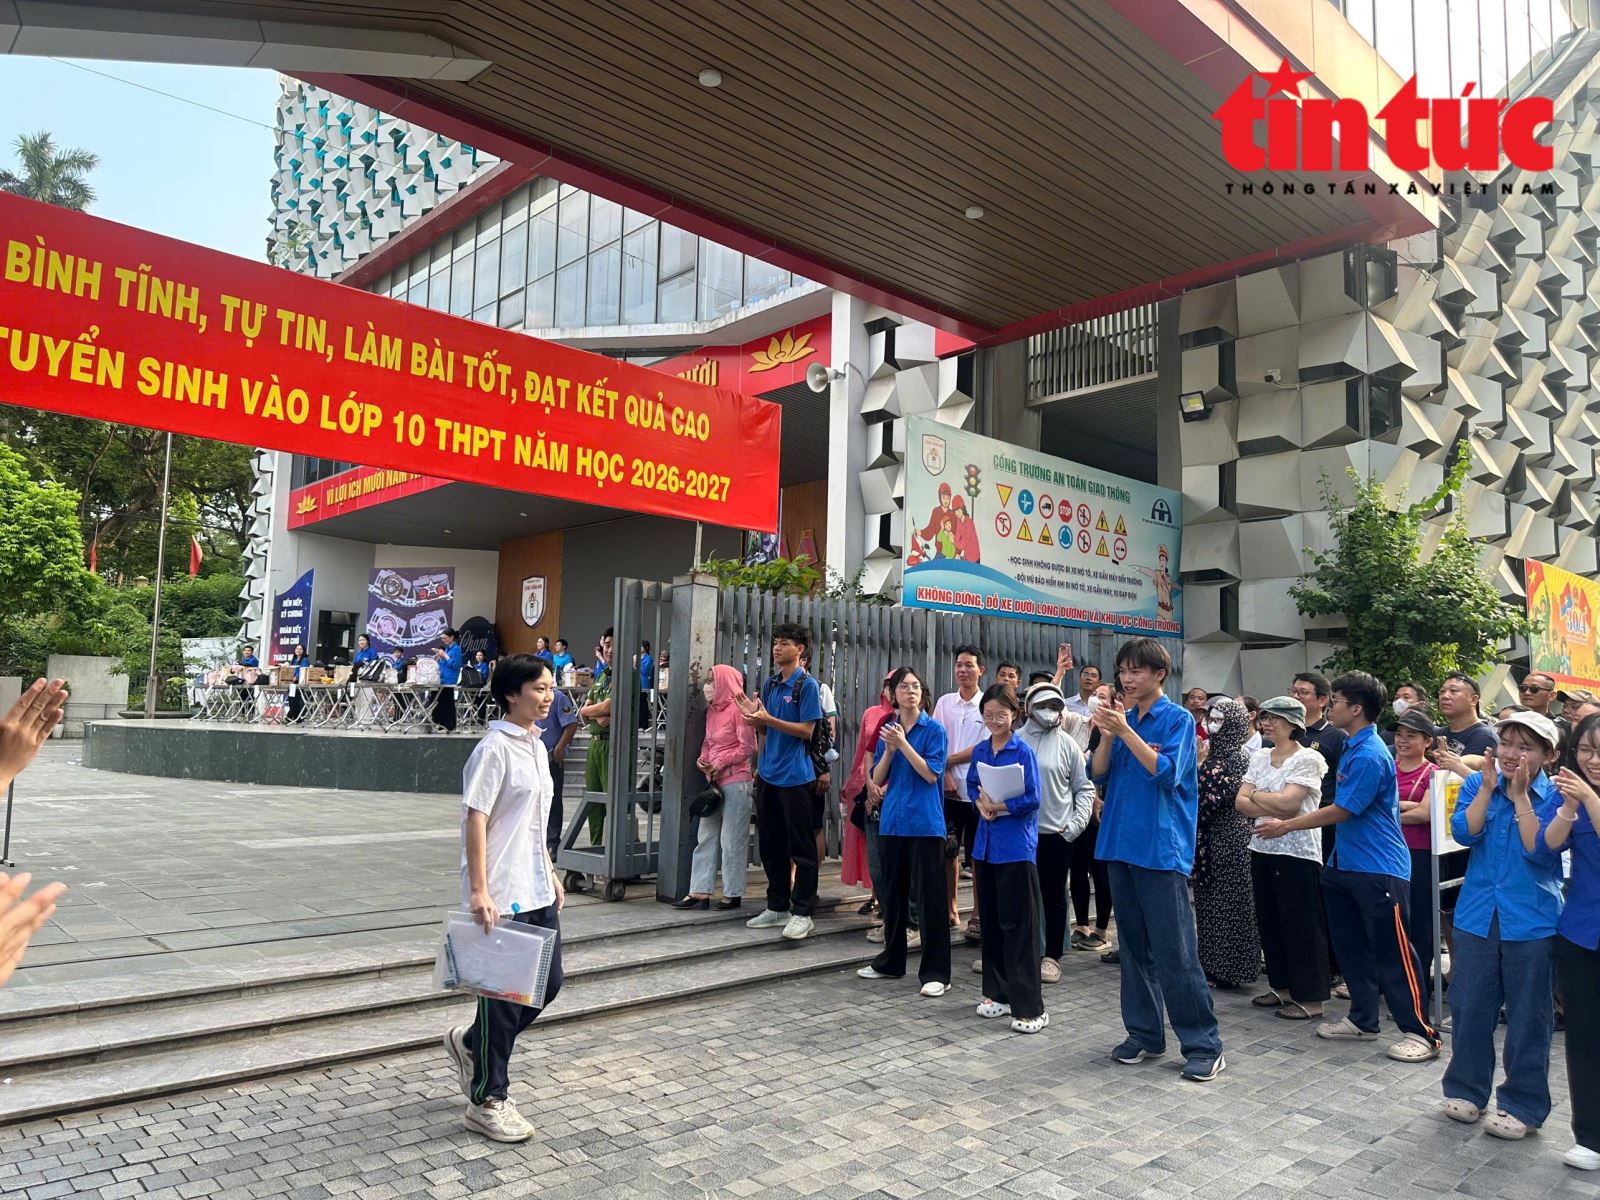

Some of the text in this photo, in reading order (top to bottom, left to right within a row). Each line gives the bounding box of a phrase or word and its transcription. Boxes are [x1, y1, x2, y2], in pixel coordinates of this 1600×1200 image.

[5, 235, 710, 442] BÌNH TĨNH, TỰ TIN, LÀM BÀI TỐT, ĐẠT KẾT QUẢ CAO
[137, 357, 228, 410] SINH
[241, 374, 310, 425] VÀO
[319, 390, 383, 437] LỚP
[393, 410, 426, 447] 10
[434, 418, 507, 462] THPT
[513, 431, 569, 473] NĂM
[576, 446, 625, 488] HỌC
[631, 459, 732, 503] 2026-2027
[335, 481, 347, 507] LỢI
[348, 477, 361, 499] ÍCH
[1019, 461, 1051, 482] TRƯỜNG
[1053, 471, 1065, 485] AN
[1066, 474, 1086, 491] TOÀN
[1088, 480, 1105, 496] GIAO
[1107, 486, 1131, 502] THÔNG
[1059, 505, 1072, 516] STOP
[917, 585, 953, 604] KHÔNG
[986, 592, 999, 610] ĐỖ
[1000, 597, 1013, 612] XE
[1015, 599, 1035, 614] DƯỚI
[1036, 602, 1058, 616] LÒNG
[1060, 605, 1088, 621] ĐƯỜNG
[1089, 608, 1099, 623] VÀ
[1101, 611, 1116, 625] KHU
[1117, 614, 1132, 629] VỰC
[1154, 619, 1181, 633] TRƯỜNG
